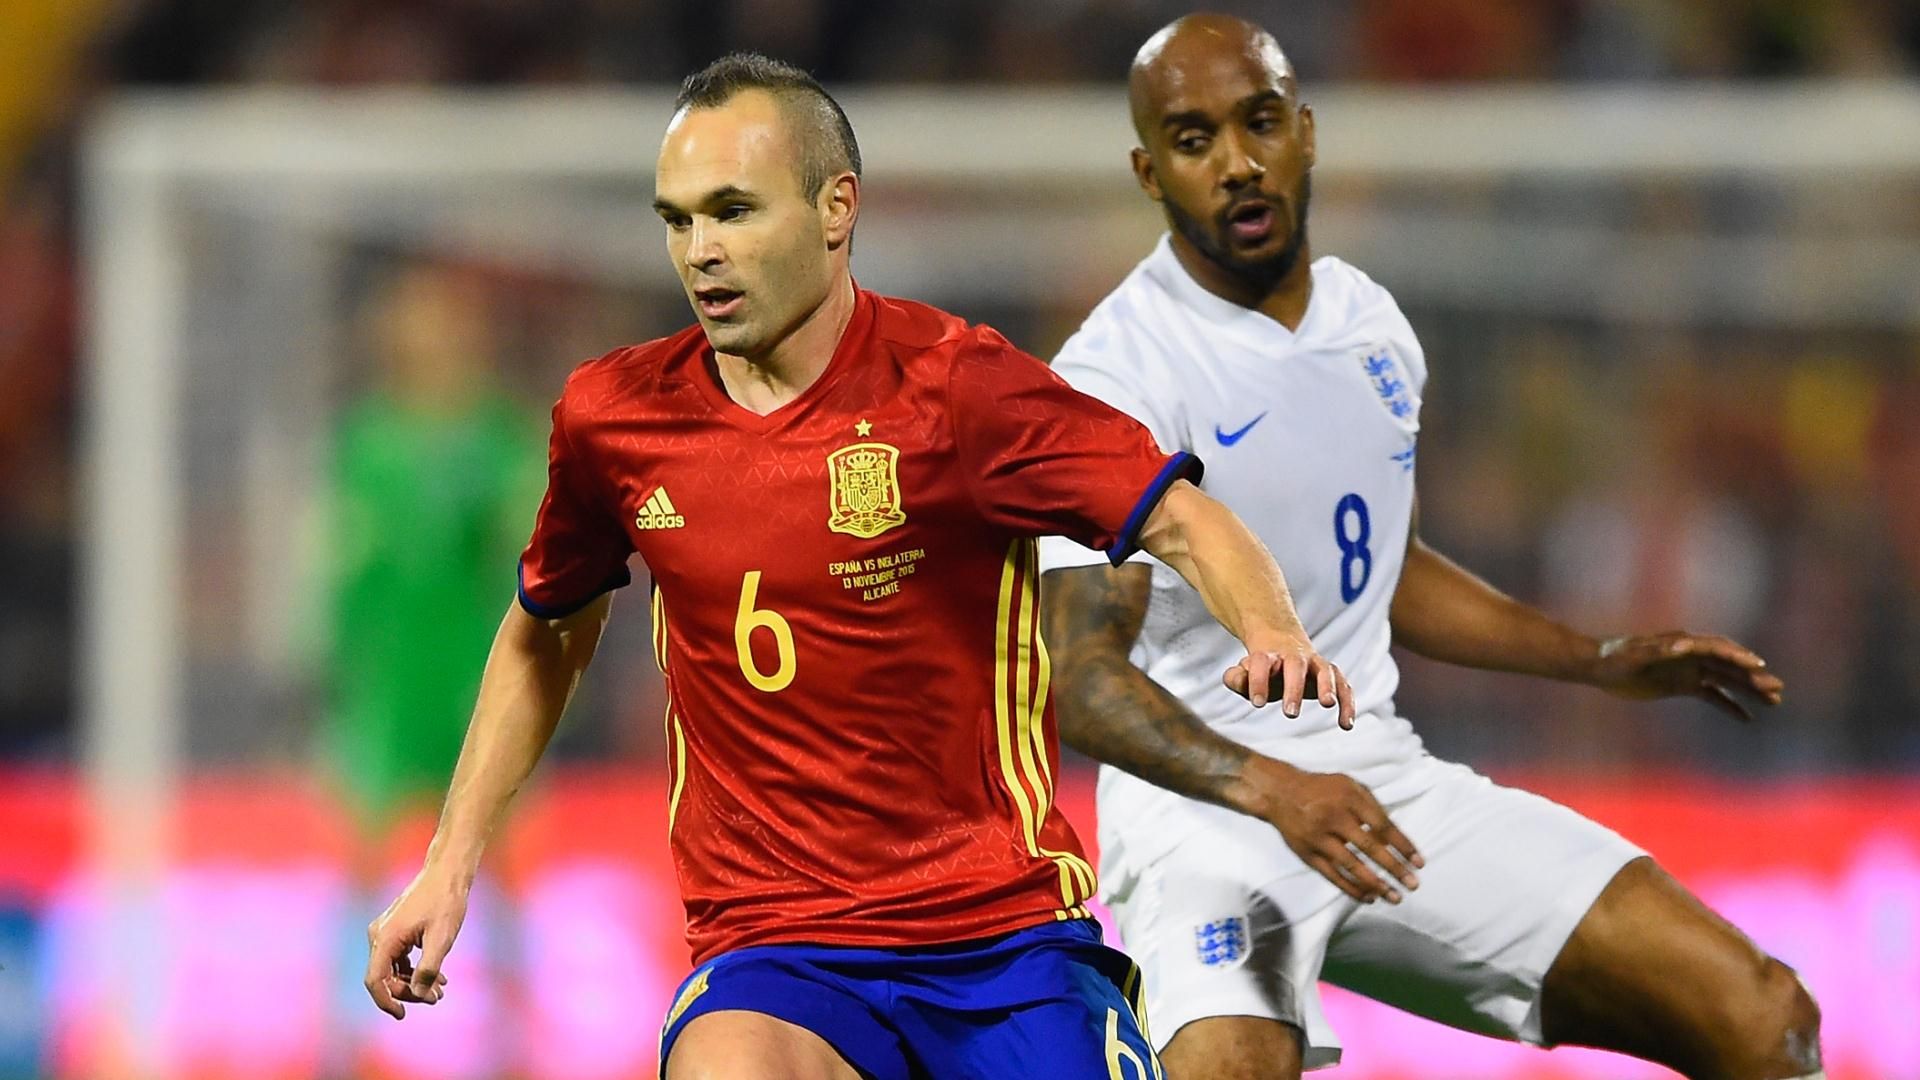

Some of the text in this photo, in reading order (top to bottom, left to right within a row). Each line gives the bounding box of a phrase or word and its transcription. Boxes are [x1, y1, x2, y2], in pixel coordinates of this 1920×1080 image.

[636, 513, 685, 529] adidas
[1334, 493, 1372, 604] 8
[829, 548, 925, 576] ESPAÑA VS INGLATERRA
[843, 564, 915, 589] 13 NOVIEMBRE 2015
[863, 581, 901, 602] ALICANTE
[735, 570, 797, 692] 6
